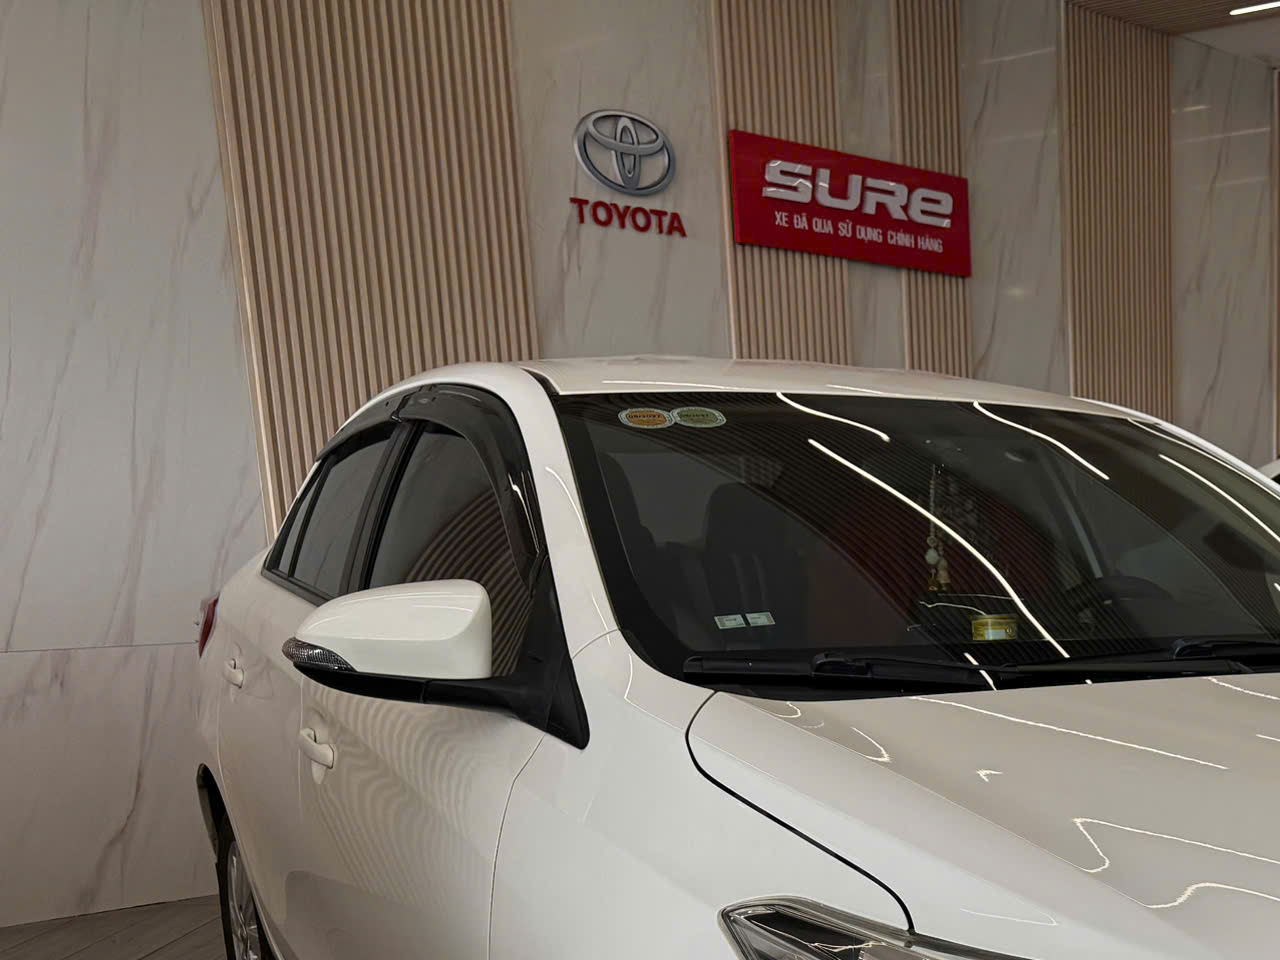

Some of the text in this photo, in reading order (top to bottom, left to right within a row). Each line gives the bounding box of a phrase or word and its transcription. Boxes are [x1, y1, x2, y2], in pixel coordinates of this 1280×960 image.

[569, 197, 688, 239] TOYOTA
[774, 210, 790, 227] XE
[812, 216, 834, 235] QUA
